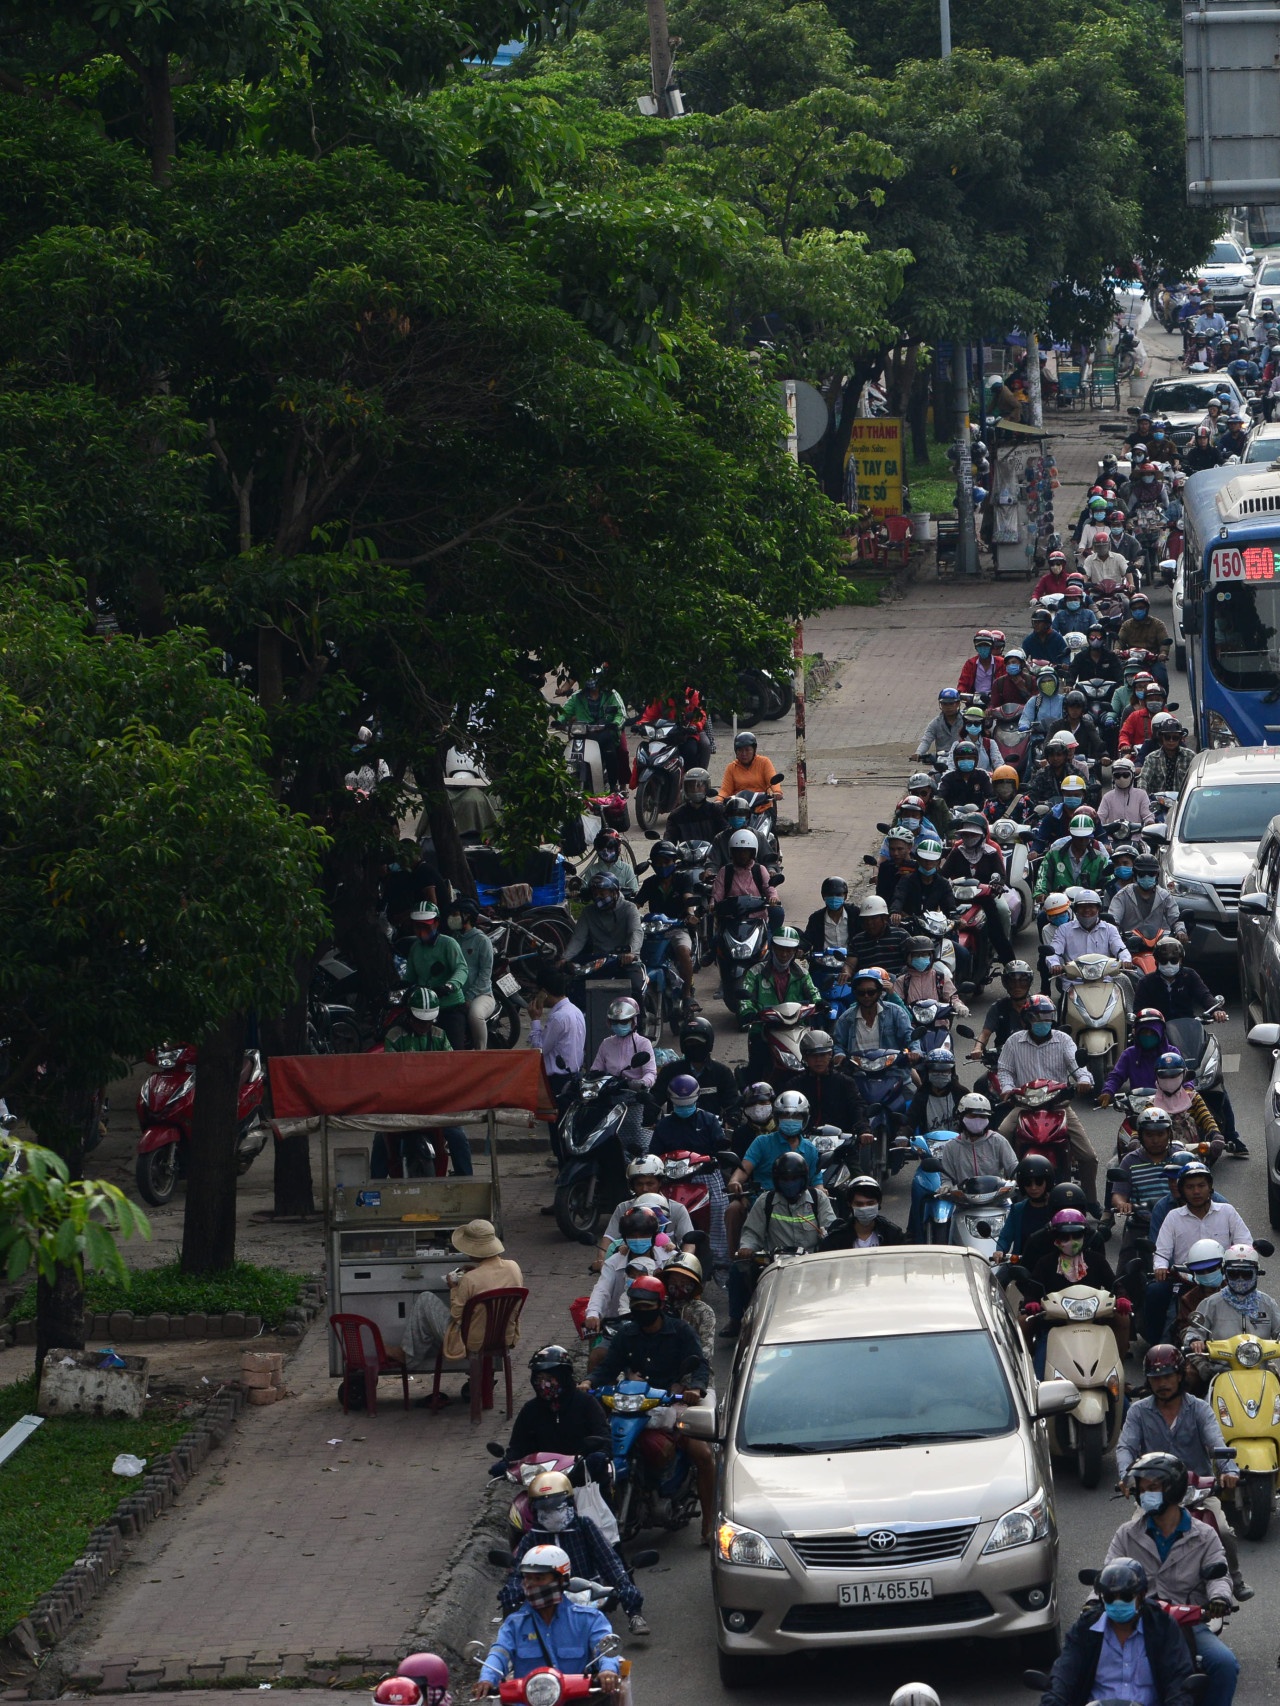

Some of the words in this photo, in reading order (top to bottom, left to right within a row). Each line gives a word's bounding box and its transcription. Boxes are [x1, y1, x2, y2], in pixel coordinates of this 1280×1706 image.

[866, 423, 898, 439] THÀNH
[863, 460, 882, 476] TAY
[884, 460, 898, 476] GA
[858, 485, 870, 500] XE
[873, 479, 888, 500] SỐ
[1213, 551, 1241, 578] 150
[841, 1581, 929, 1603] 51A-465.54
